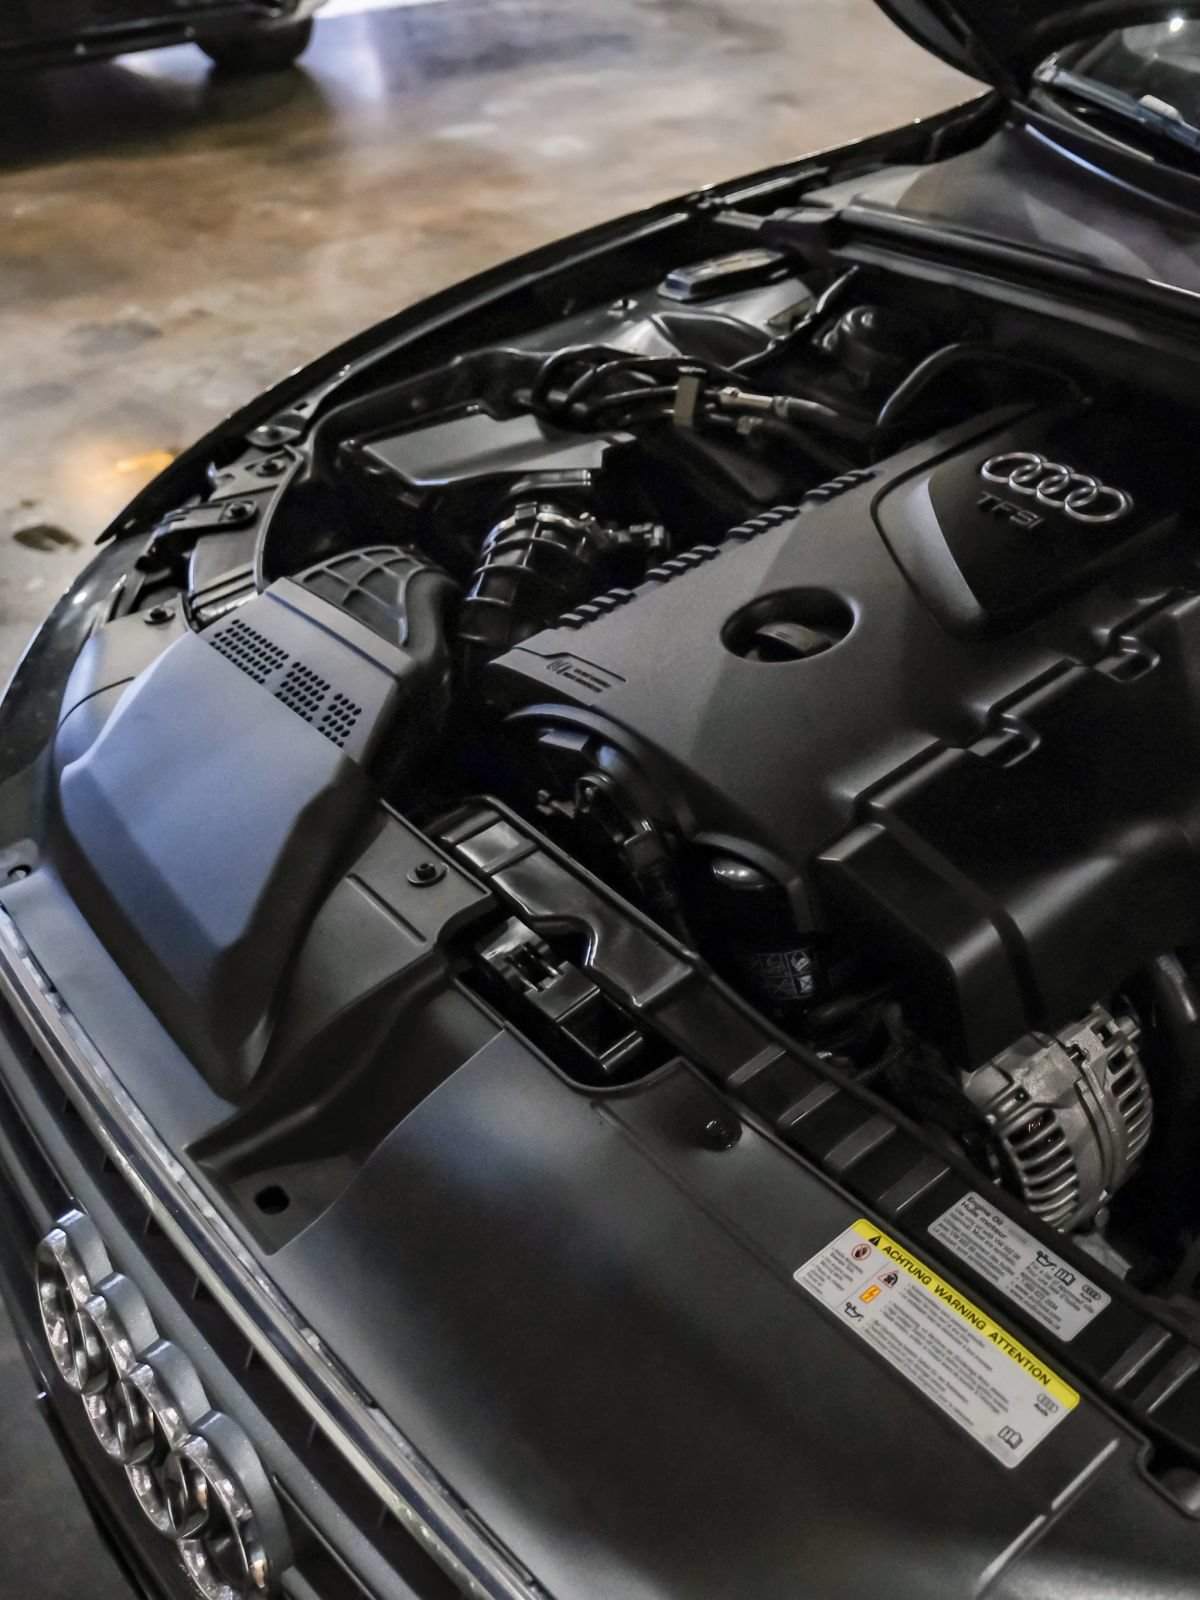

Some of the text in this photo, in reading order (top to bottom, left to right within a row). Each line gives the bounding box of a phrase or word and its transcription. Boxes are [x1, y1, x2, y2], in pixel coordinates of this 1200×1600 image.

[977, 491, 1044, 529] TFSI
[966, 1196, 993, 1218] Engine
[978, 1216, 1008, 1239] moteur
[882, 1245, 932, 1286] ACHTUNG
[933, 1283, 987, 1331] WARNING
[987, 1331, 1051, 1386] ATTENTION
